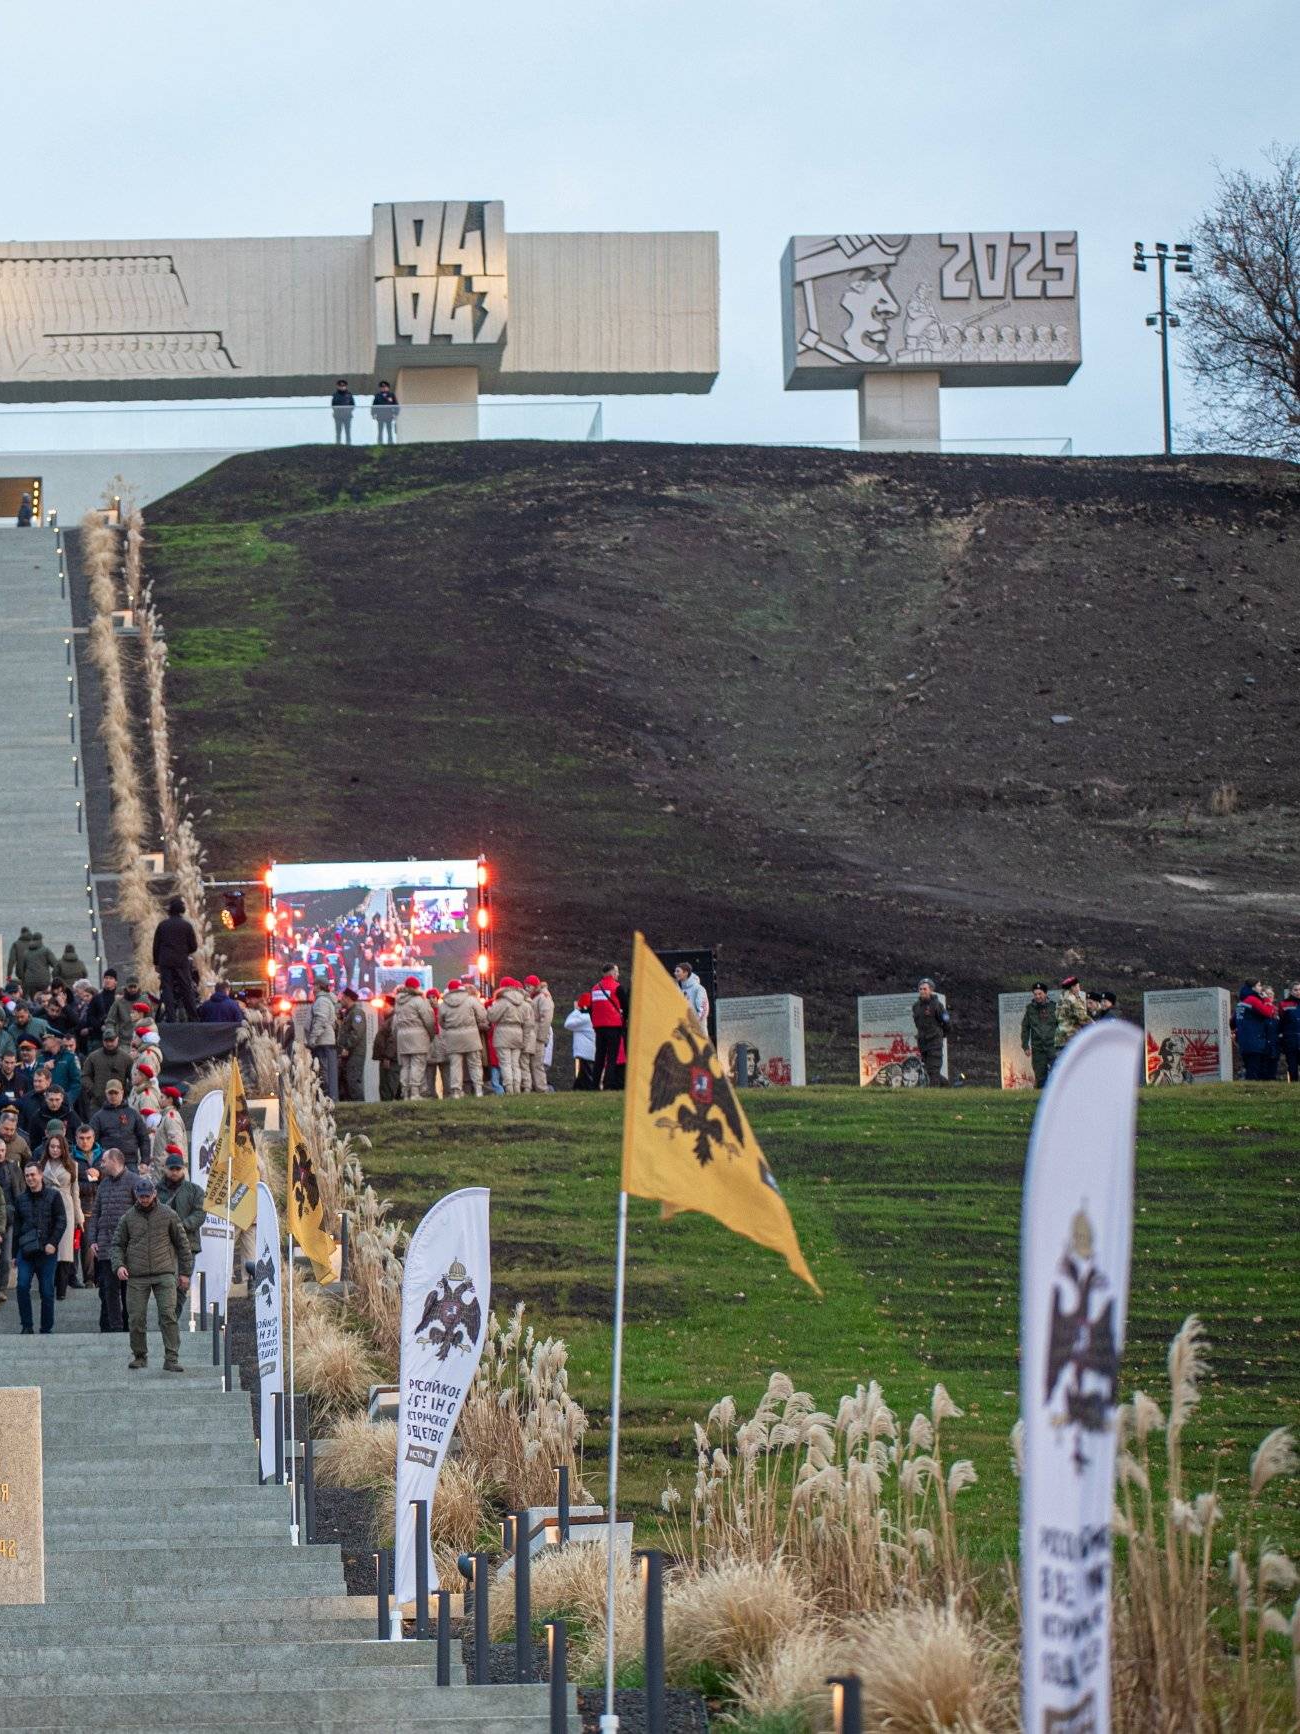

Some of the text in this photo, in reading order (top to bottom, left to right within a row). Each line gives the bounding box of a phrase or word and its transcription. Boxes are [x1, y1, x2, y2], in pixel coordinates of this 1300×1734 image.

[373, 201, 506, 276] 1941
[939, 231, 1077, 299] 2025
[375, 276, 507, 344] 1943
